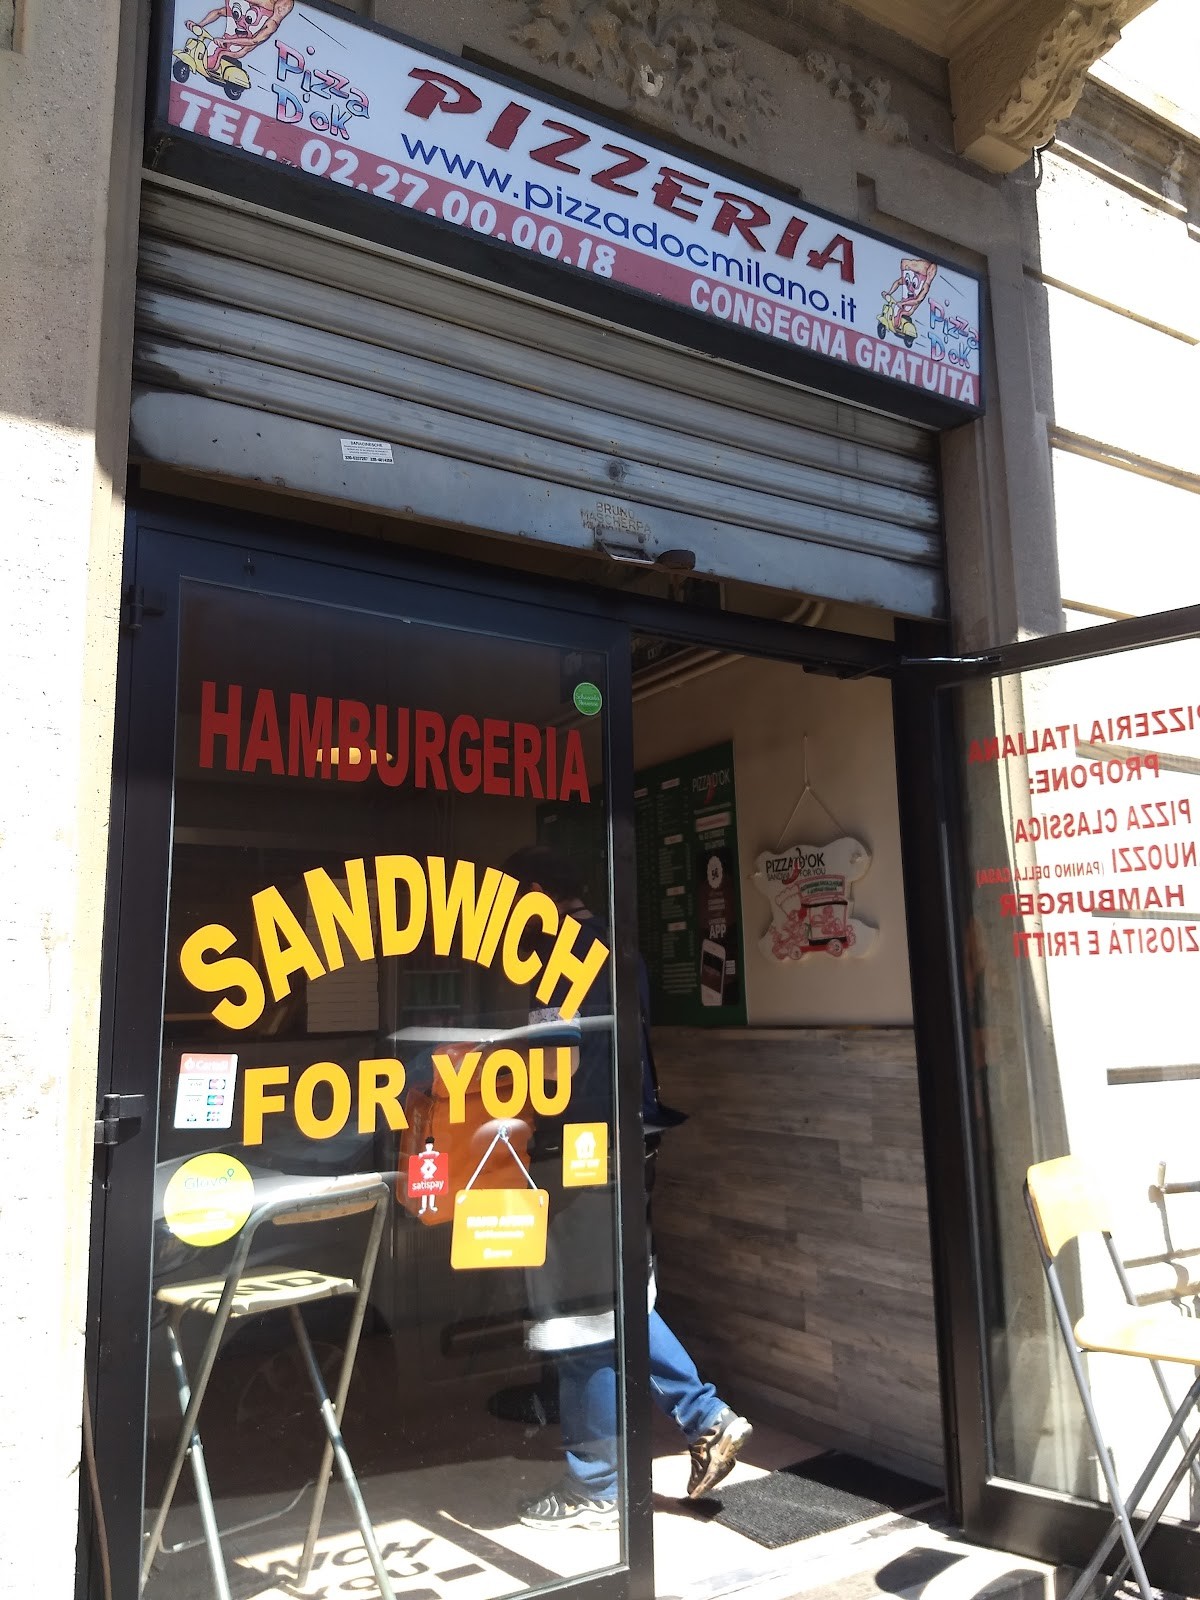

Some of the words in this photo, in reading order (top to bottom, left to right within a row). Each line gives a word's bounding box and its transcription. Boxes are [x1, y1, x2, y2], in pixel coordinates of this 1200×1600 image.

[274, 39, 371, 119] Pizza
[179, 91, 277, 161] TEL.
[300, 138, 617, 279] 02.27.00.00.18
[401, 133, 857, 323] www.pizzadocmilano.it
[404, 67, 855, 284] PIZZERIA
[690, 279, 849, 365] CONSEGNA
[855, 338, 976, 406] GRATUITA
[927, 297, 979, 350] Pizza
[200, 680, 591, 803] HAMBURGERIA
[180, 854, 610, 1030] SANDWICH
[709, 924, 727, 940] APP
[243, 1058, 410, 1146] FOR
[431, 1046, 572, 1124] YOU
[184, 1176, 229, 1190] Glovo
[411, 1179, 445, 1192] satispay
